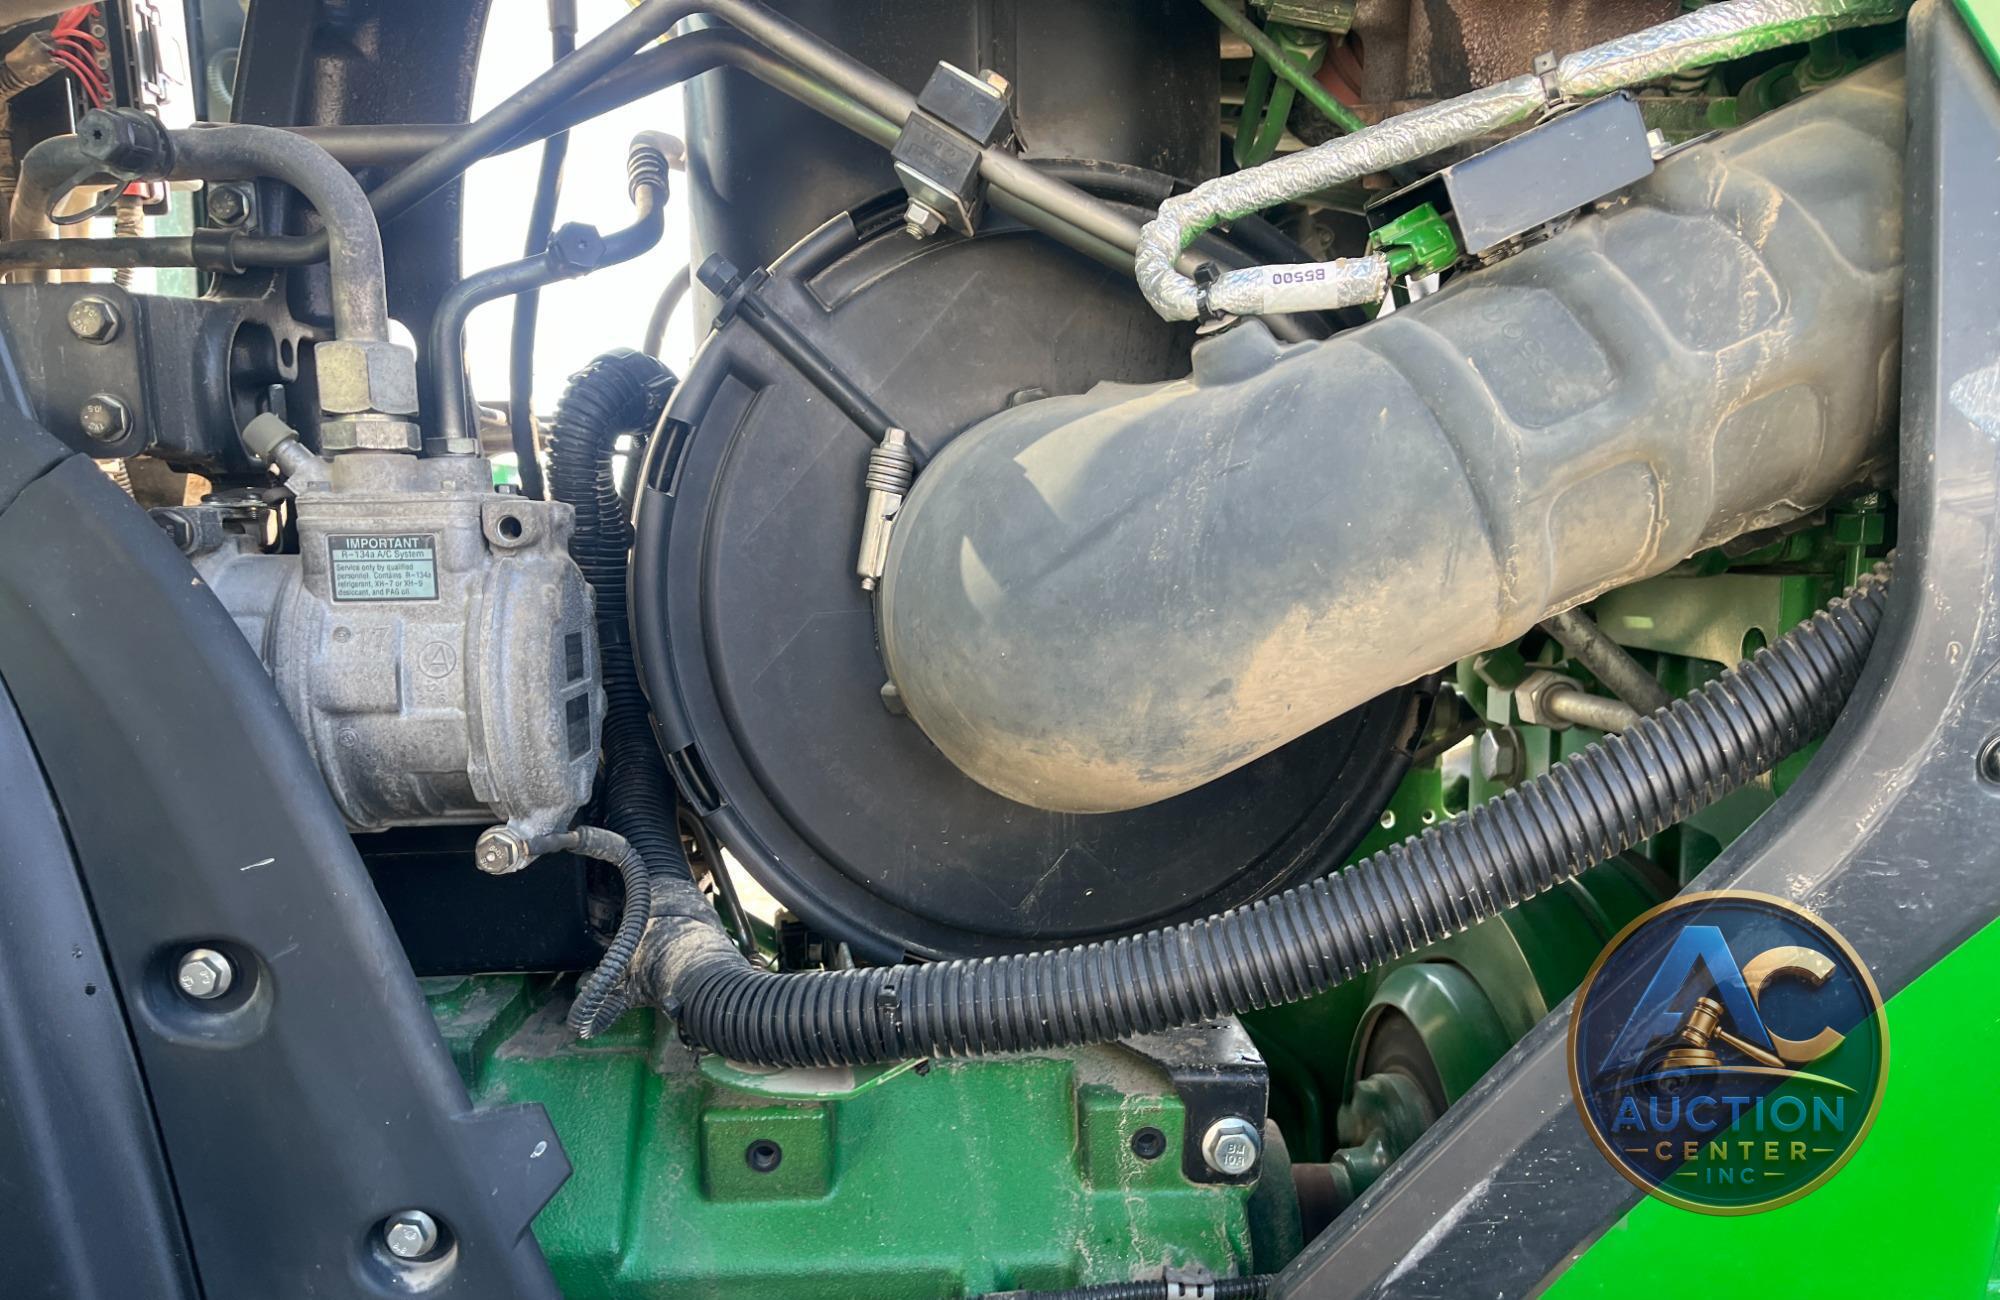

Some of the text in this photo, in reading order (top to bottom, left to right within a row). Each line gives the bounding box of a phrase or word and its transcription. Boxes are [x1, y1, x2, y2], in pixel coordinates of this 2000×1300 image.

[1273, 268, 1326, 285] B5500
[346, 537, 419, 549] IMPORTANT
[341, 550, 424, 560] R-134a A/C System
[362, 563, 376, 572] only
[377, 563, 385, 572] by
[387, 563, 414, 572] qualified
[373, 571, 402, 579] Contains
[374, 580, 394, 588] XH-7
[372, 588, 384, 596] and
[386, 588, 400, 596] PAG
